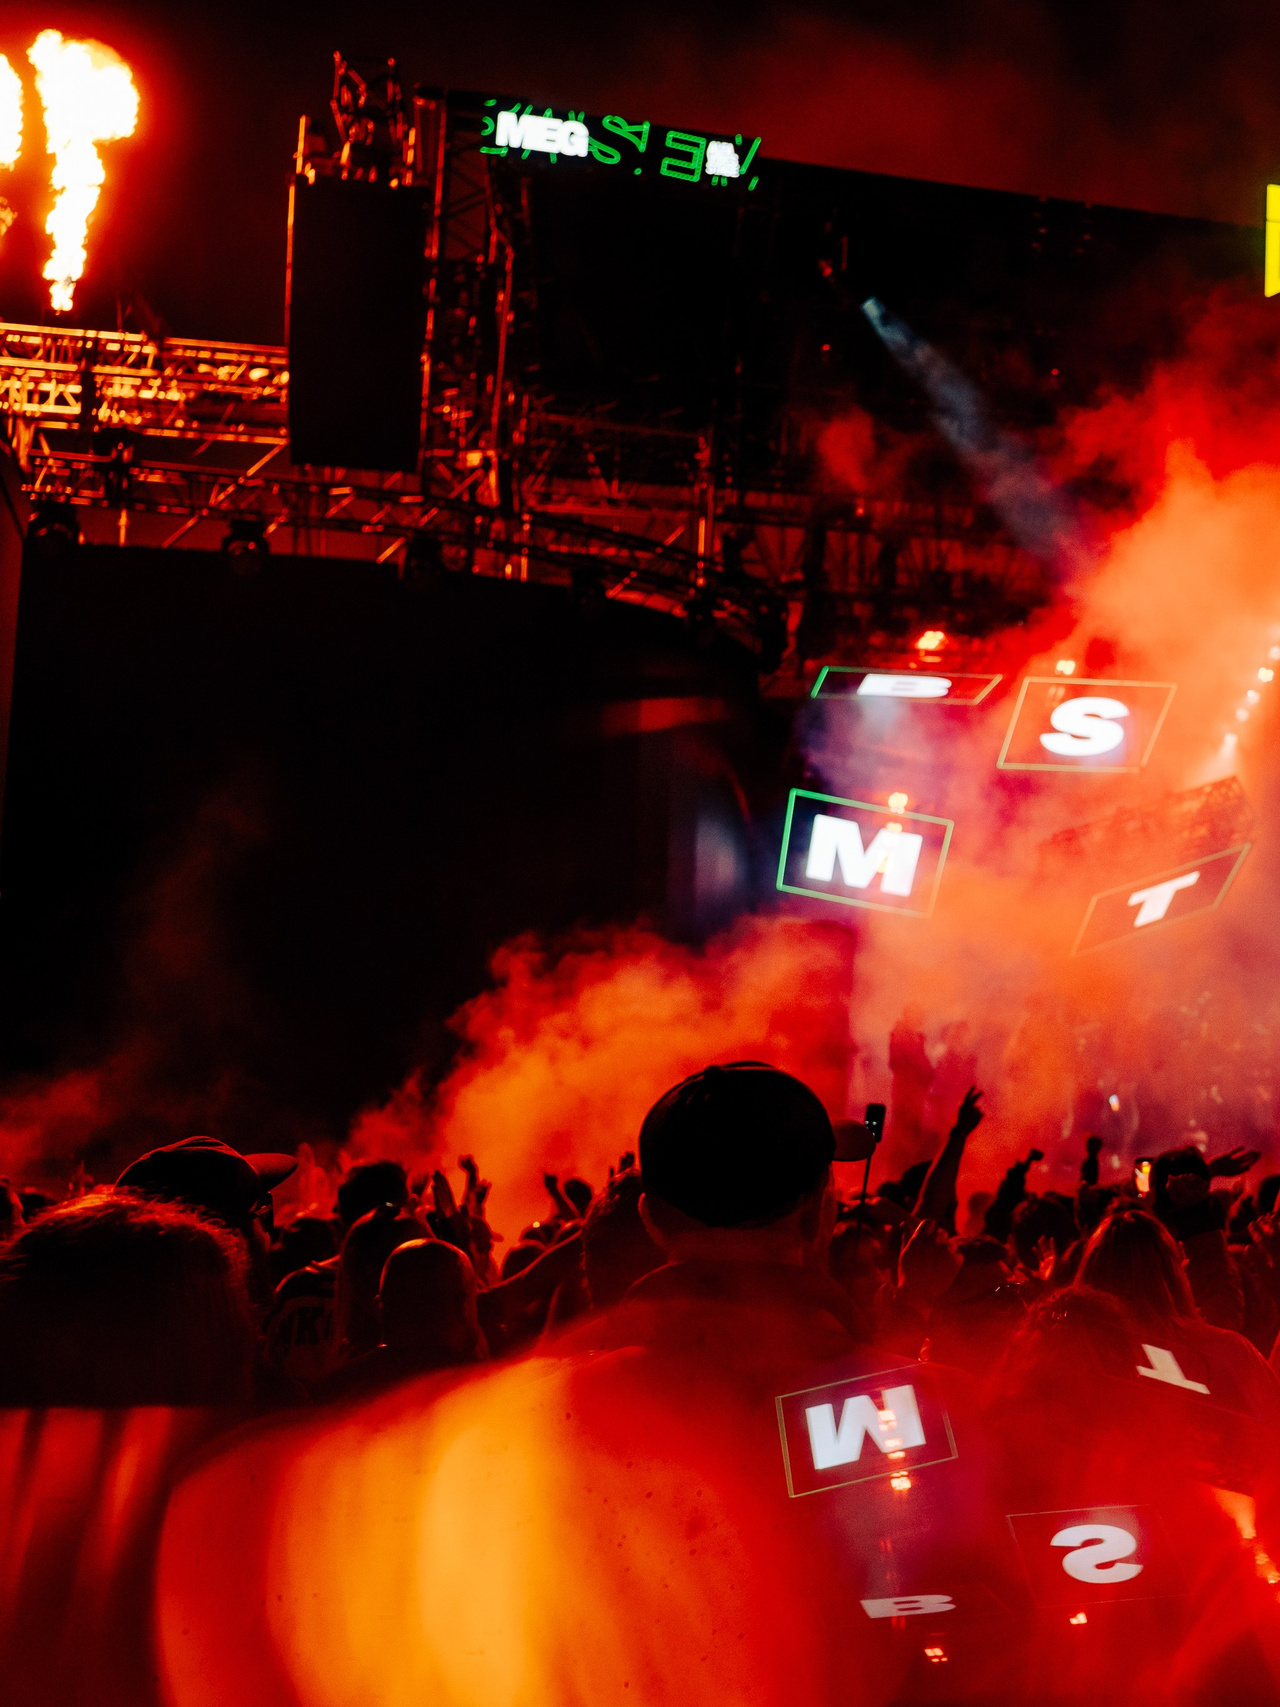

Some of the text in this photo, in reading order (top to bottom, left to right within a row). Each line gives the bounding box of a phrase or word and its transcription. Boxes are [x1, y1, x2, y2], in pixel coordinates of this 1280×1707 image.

[1039, 696, 1131, 758] S
[805, 813, 924, 899] M
[1127, 870, 1201, 929] T
